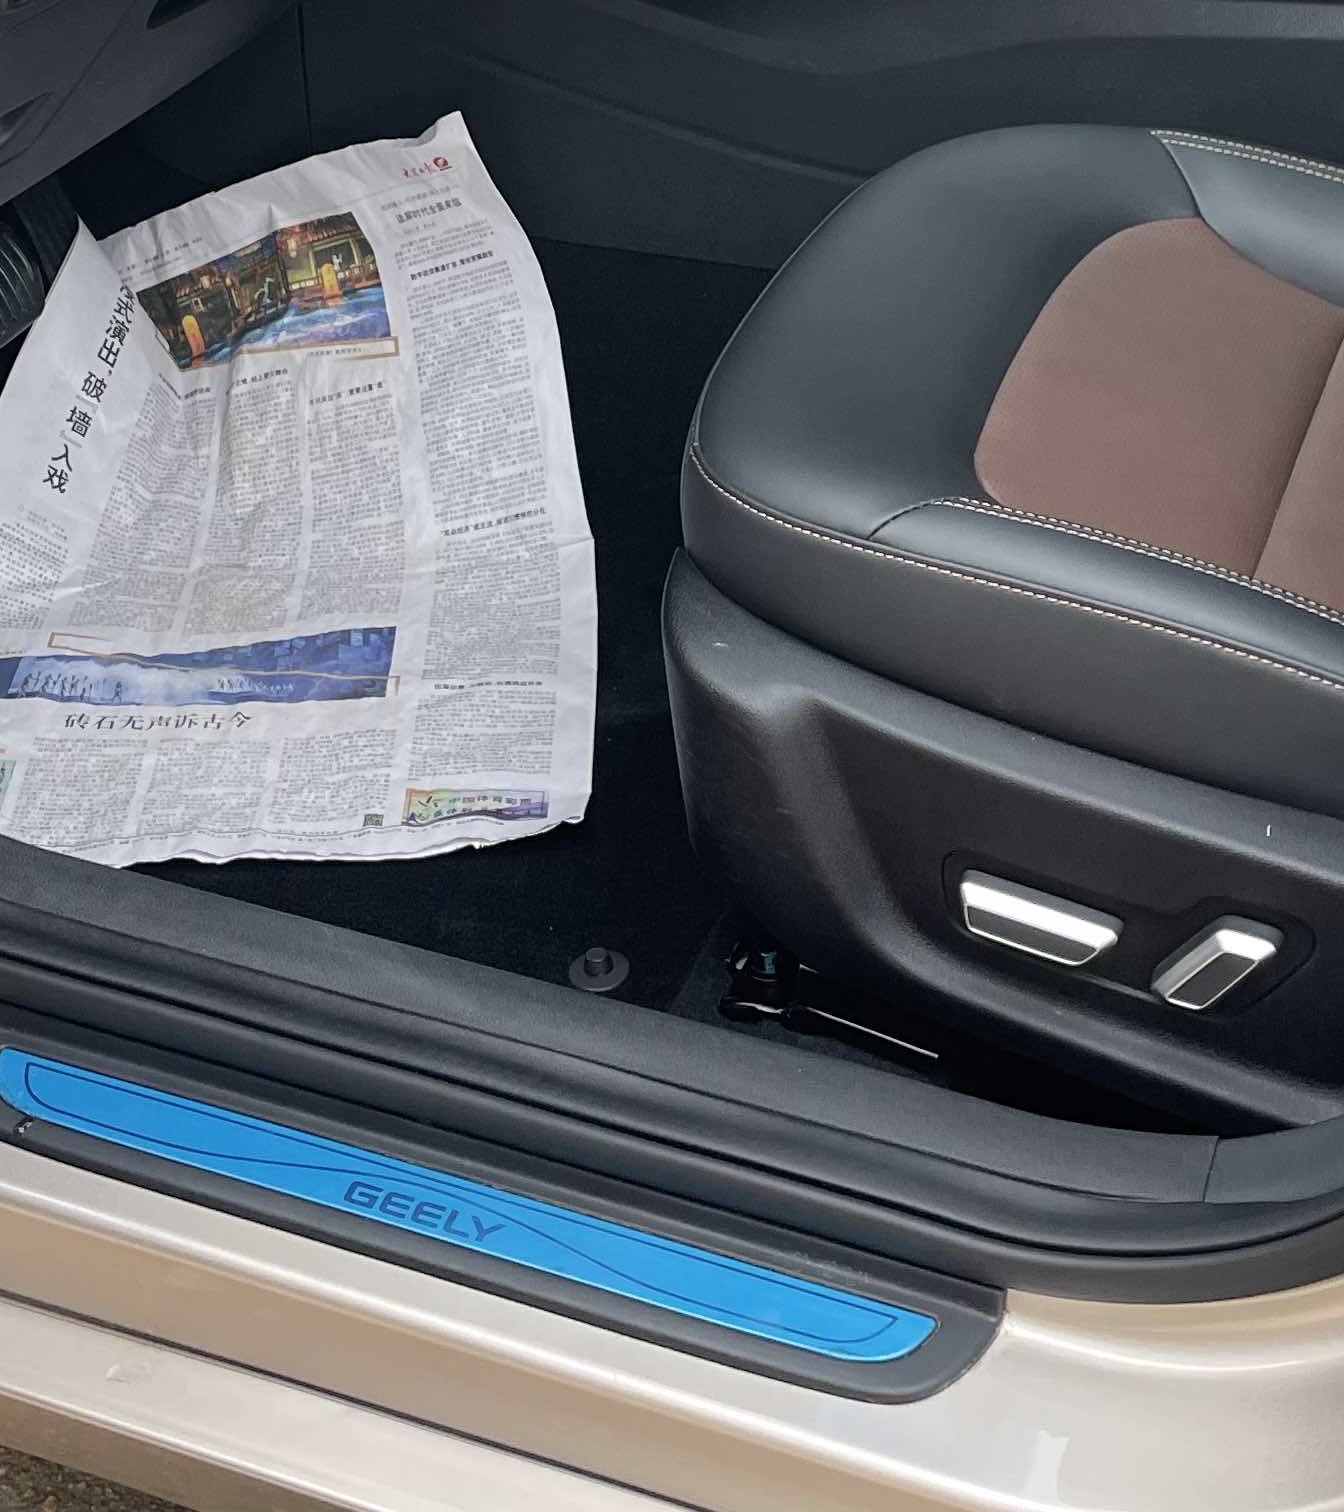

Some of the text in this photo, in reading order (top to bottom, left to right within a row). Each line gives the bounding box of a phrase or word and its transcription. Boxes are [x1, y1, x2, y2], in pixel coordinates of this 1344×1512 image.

[64, 711, 252, 731] 砖石无声诉古今
[343, 1180, 507, 1243] GEELY
